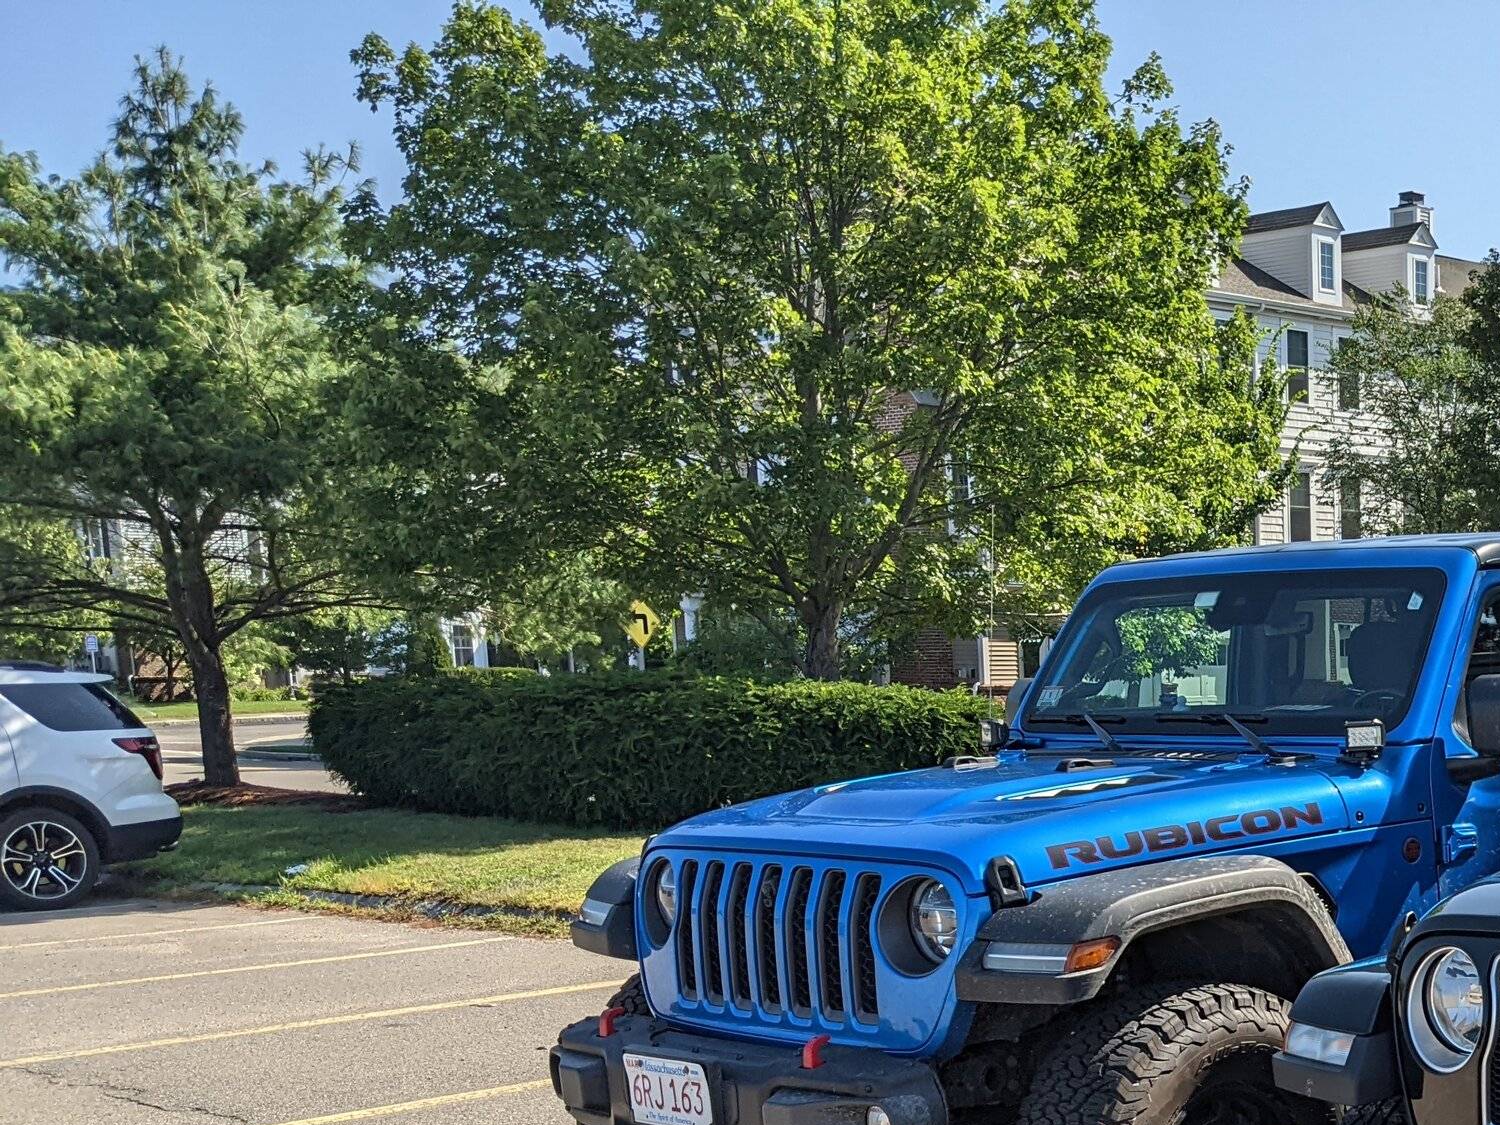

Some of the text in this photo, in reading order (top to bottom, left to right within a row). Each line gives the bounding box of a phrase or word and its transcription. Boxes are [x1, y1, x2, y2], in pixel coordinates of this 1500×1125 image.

[1045, 802, 1324, 870] RUBICON
[633, 1074, 704, 1116] 6RJ 163
